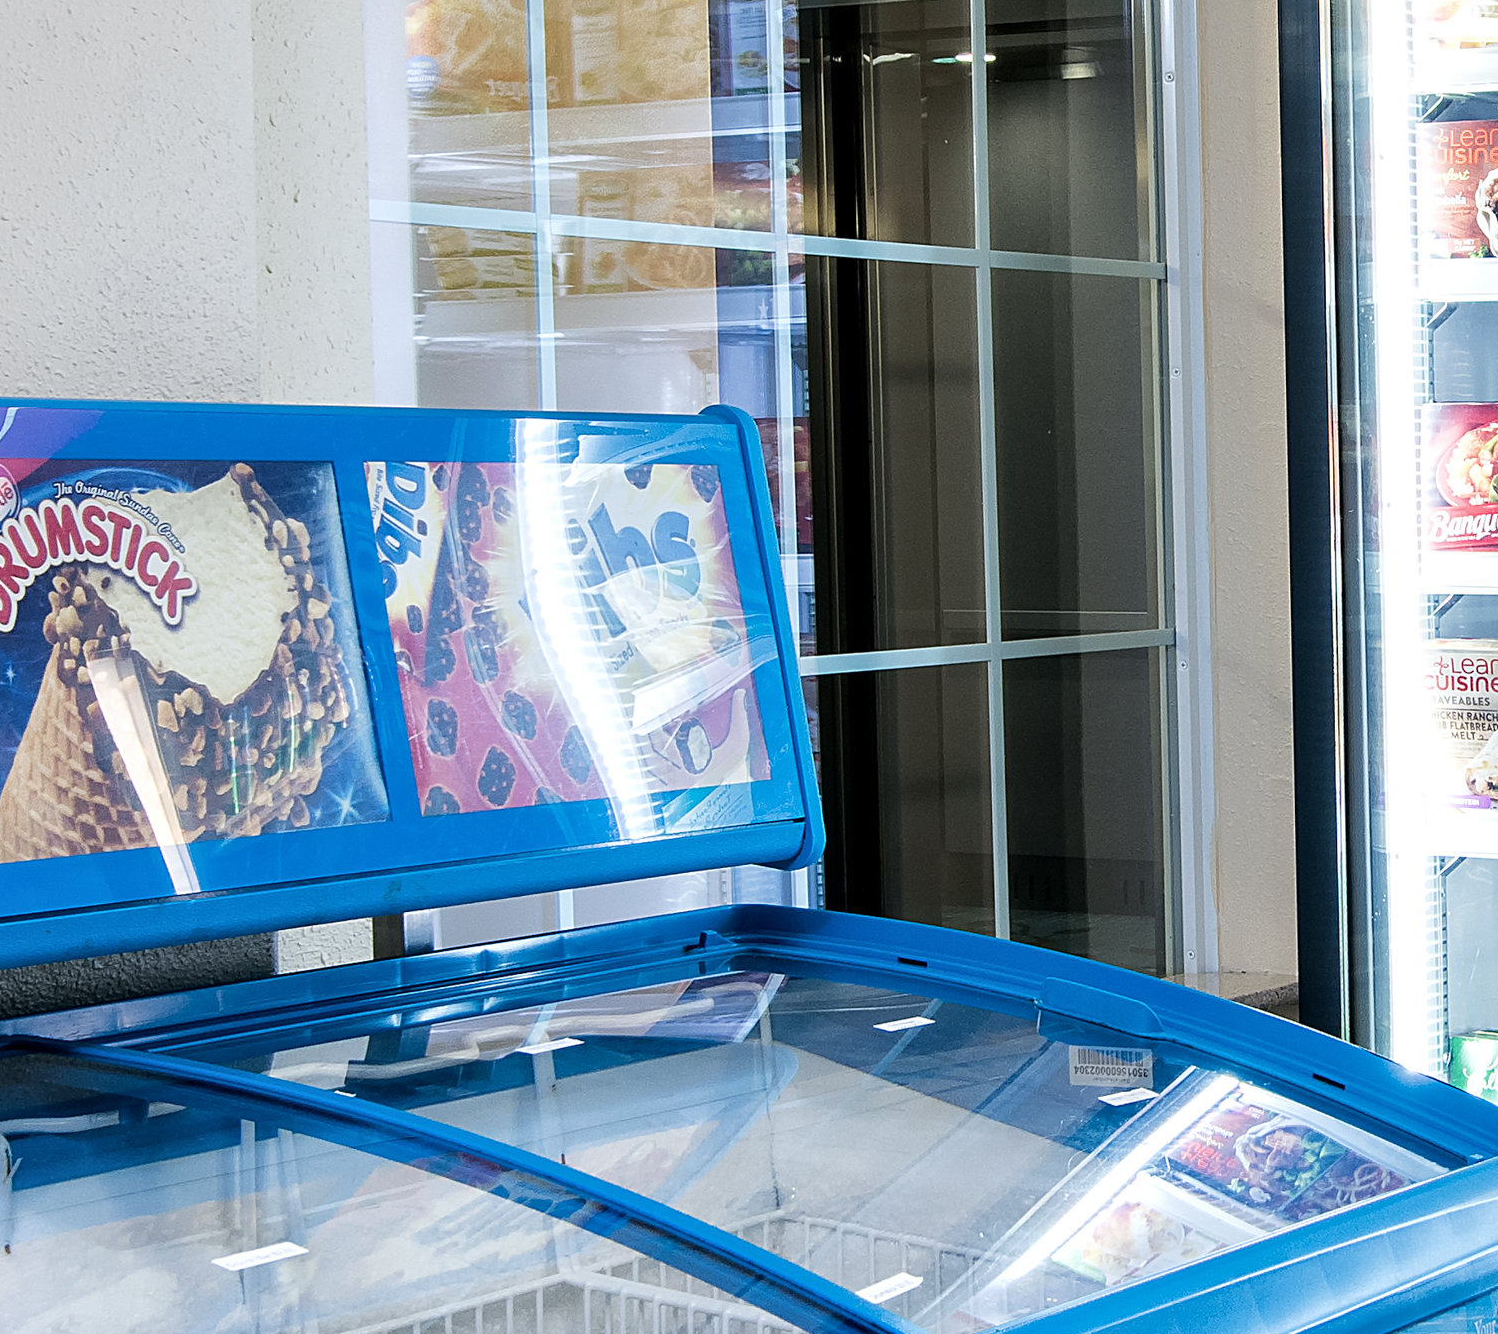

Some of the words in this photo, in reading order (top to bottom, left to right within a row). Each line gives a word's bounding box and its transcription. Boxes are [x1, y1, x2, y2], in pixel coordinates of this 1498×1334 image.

[54, 482, 73, 499] The
[75, 481, 119, 501] Original
[119, 493, 160, 527] Sundae
